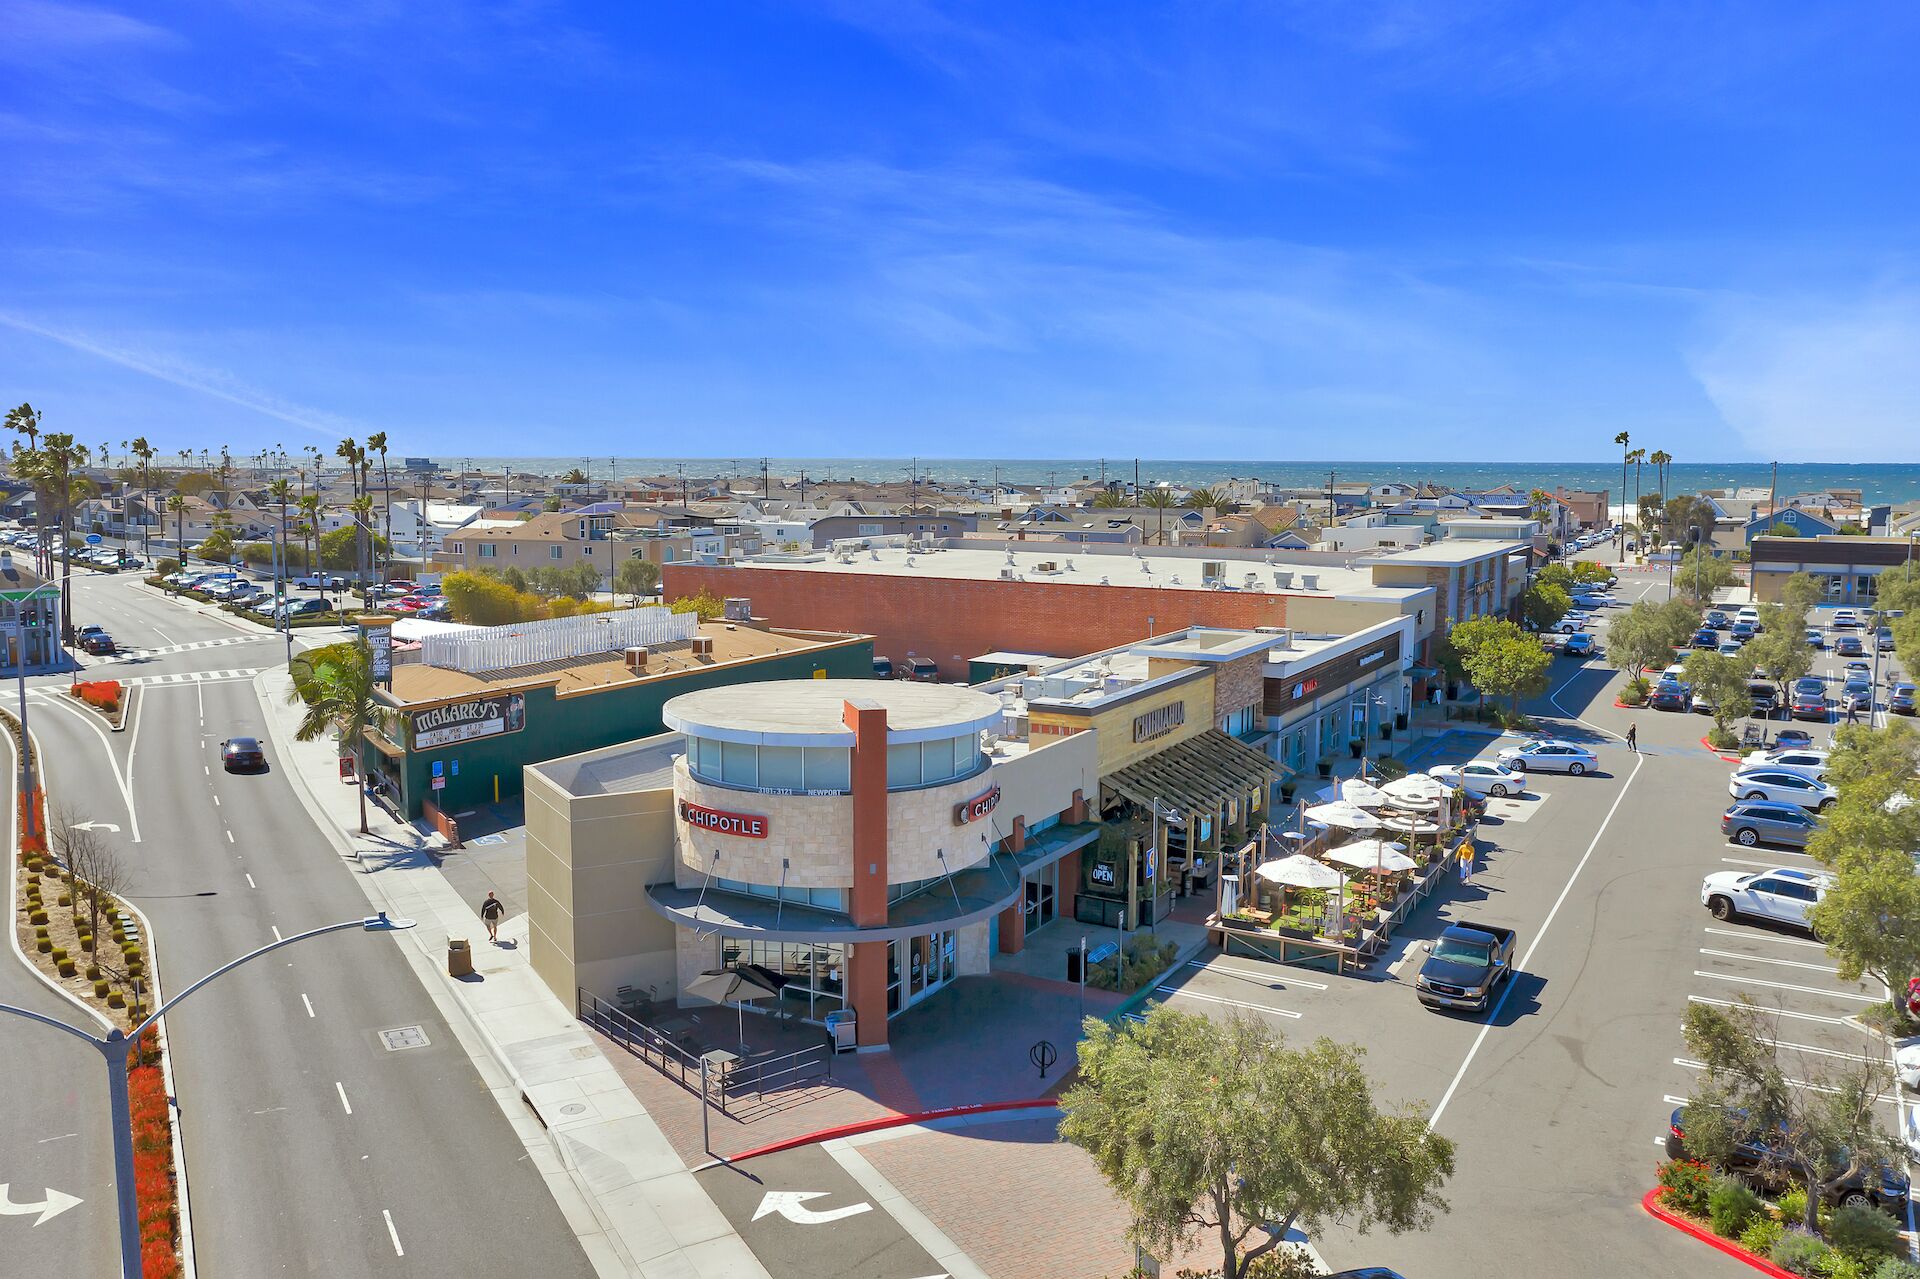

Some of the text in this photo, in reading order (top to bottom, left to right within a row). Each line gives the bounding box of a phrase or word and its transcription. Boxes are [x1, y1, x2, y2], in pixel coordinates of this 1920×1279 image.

[416, 701, 500, 732] MALARKY'S
[687, 808, 761, 835] CHIPOTLE
[1093, 869, 1113, 882] OPEN
